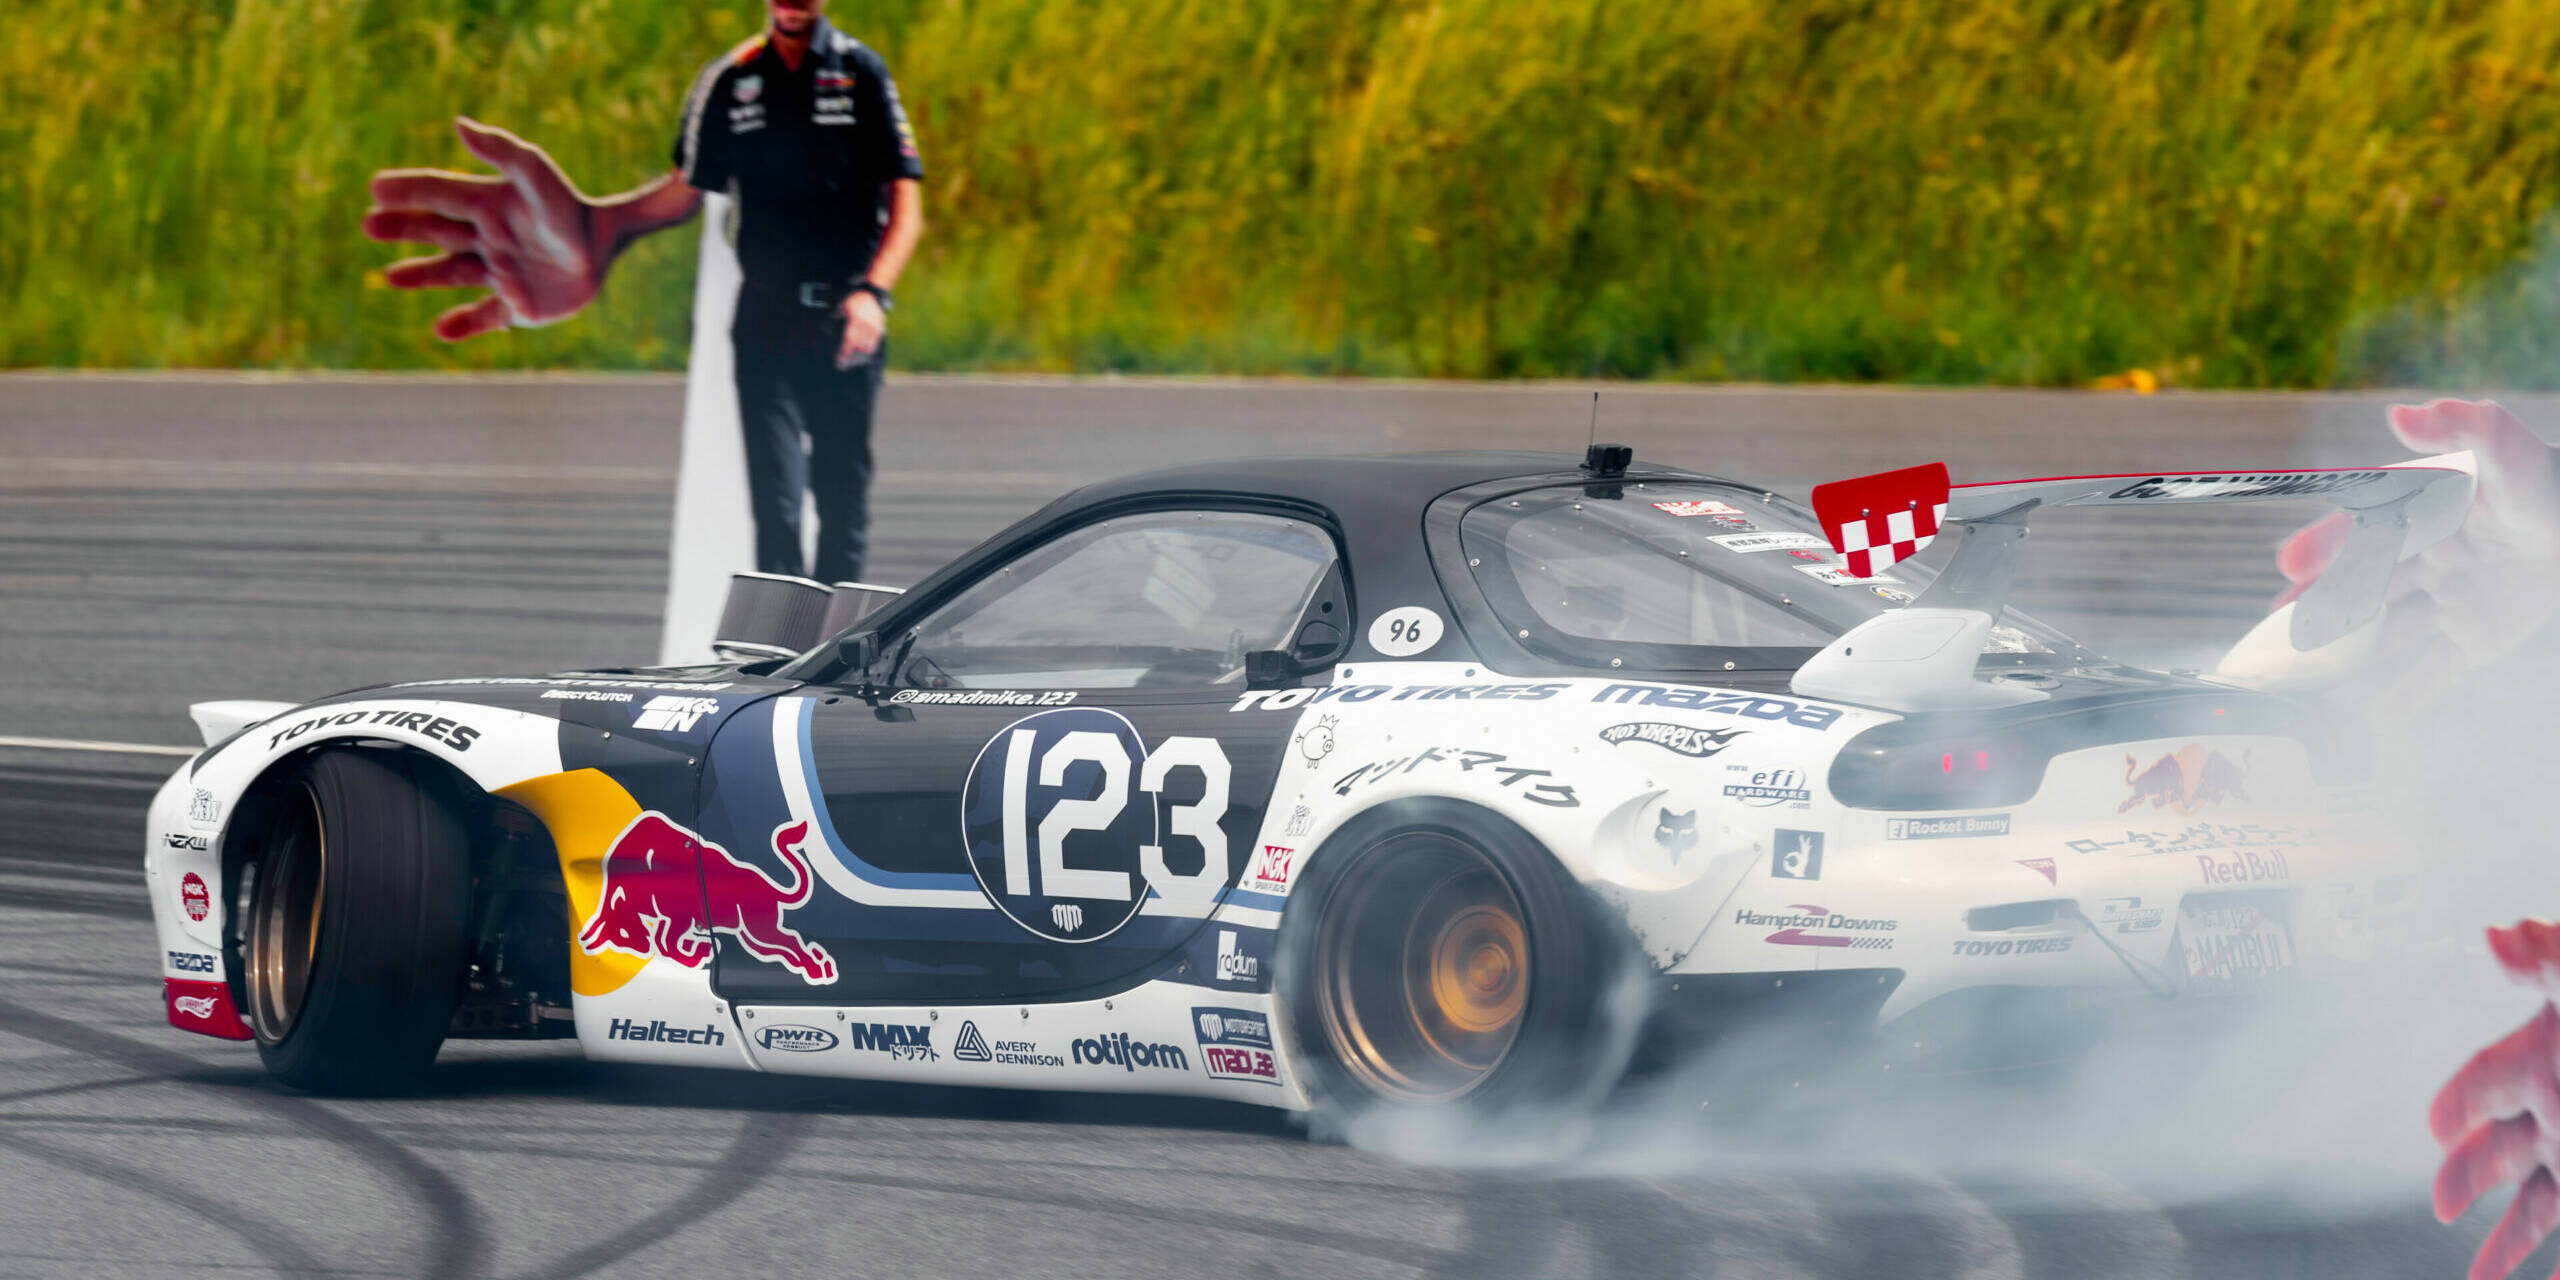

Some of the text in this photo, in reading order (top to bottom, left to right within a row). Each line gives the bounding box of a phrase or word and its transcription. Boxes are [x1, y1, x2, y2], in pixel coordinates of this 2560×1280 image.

[1390, 618, 1420, 643] 96
[1229, 683, 1574, 712] TOYO TIRES
[1591, 684, 1844, 732] mazda
[269, 711, 481, 752] TOYO TIRES
[1605, 724, 1635, 742] HOT
[1752, 769, 1795, 787] efi
[1726, 786, 1809, 800] HARDWARE
[1002, 728, 1232, 904] 123
[1909, 818, 2010, 835] Rocket Bunny
[1258, 847, 1295, 881] NGK
[2197, 851, 2249, 885] Red
[2246, 849, 2289, 882] Bull
[1735, 908, 1898, 931] Hampton Downs
[1952, 936, 2074, 956] TOYO TIRES
[608, 1018, 725, 1046] Haltech
[764, 1028, 828, 1050] PWR
[851, 1022, 931, 1051] MAX
[891, 1045, 941, 1062] ドリフト
[995, 1041, 1037, 1053] AVERY
[1071, 1032, 1190, 1072] rotiform
[996, 1052, 1064, 1067] DENNISON
